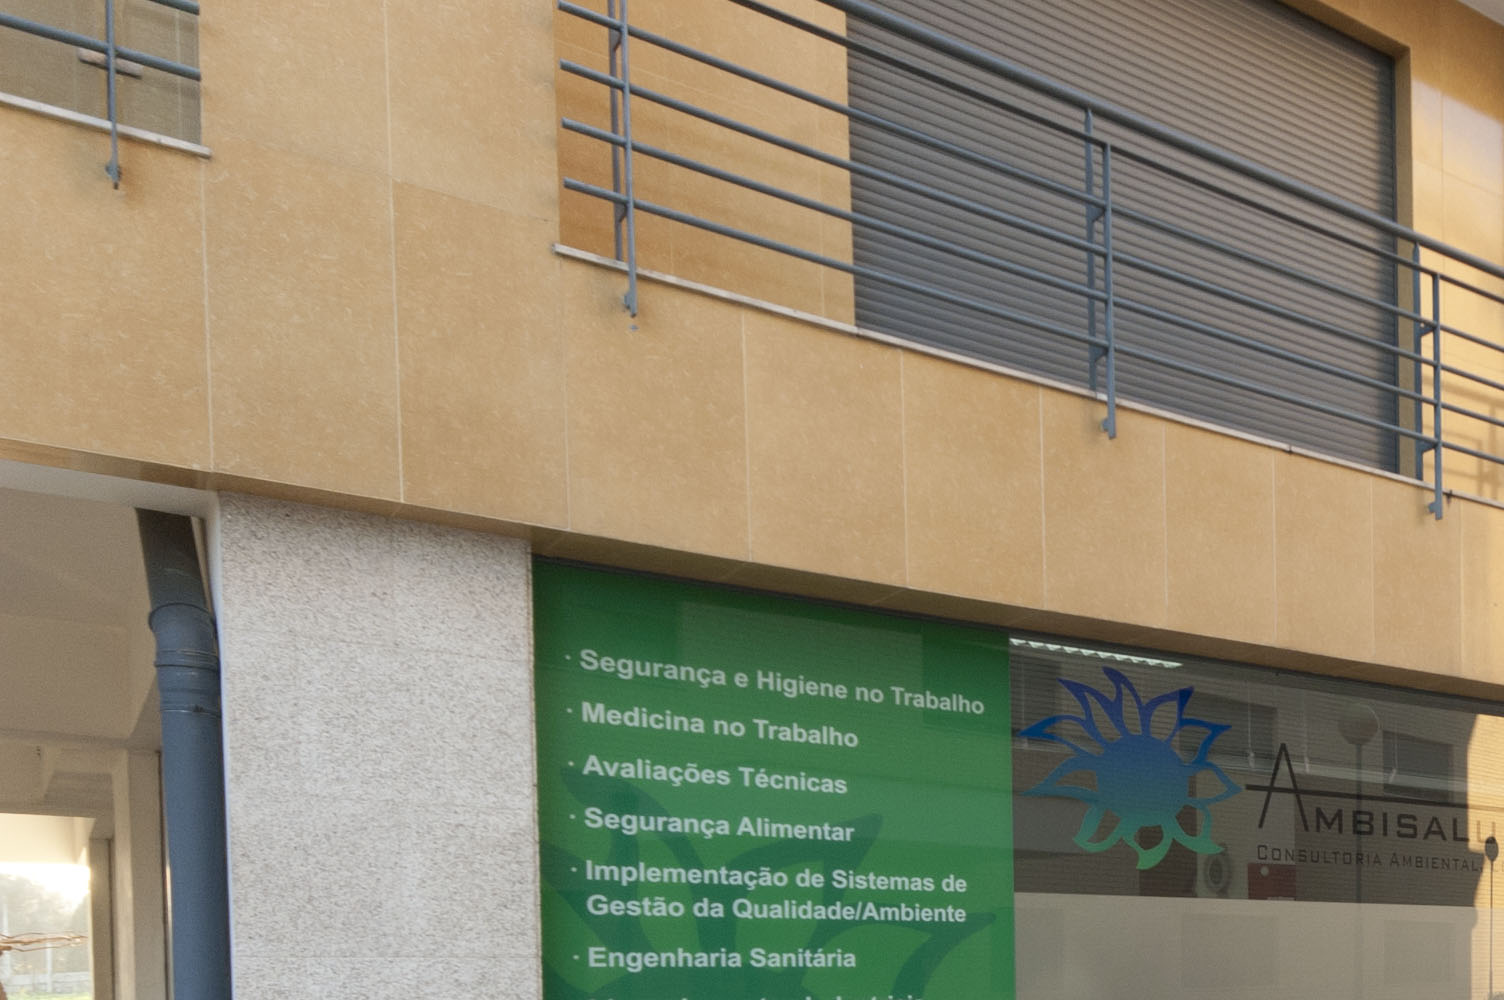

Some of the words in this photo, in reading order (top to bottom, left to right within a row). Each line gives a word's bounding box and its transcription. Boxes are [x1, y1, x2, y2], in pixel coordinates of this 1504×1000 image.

[580, 649, 726, 688] Segurança
[734, 671, 748, 688] e
[757, 671, 847, 699] Higiene
[856, 686, 884, 703] no
[891, 687, 984, 715] Trabalho
[582, 701, 704, 733] Medicina
[714, 719, 745, 737] no
[754, 719, 858, 748] Trabalho
[583, 755, 730, 786] Avaliações
[739, 764, 847, 794] Técnicas
[585, 807, 730, 839] Segurança
[737, 817, 854, 842] Alimentar
[586, 861, 788, 889] Implementação
[795, 869, 824, 889] de
[832, 871, 934, 891] Sistemas
[942, 875, 967, 892] de
[587, 896, 685, 916] Gestão
[693, 899, 724, 917] da
[732, 900, 966, 923] Qualidade/Ambiente
[588, 948, 741, 972] Engenharia
[750, 949, 856, 968] Sanitária
